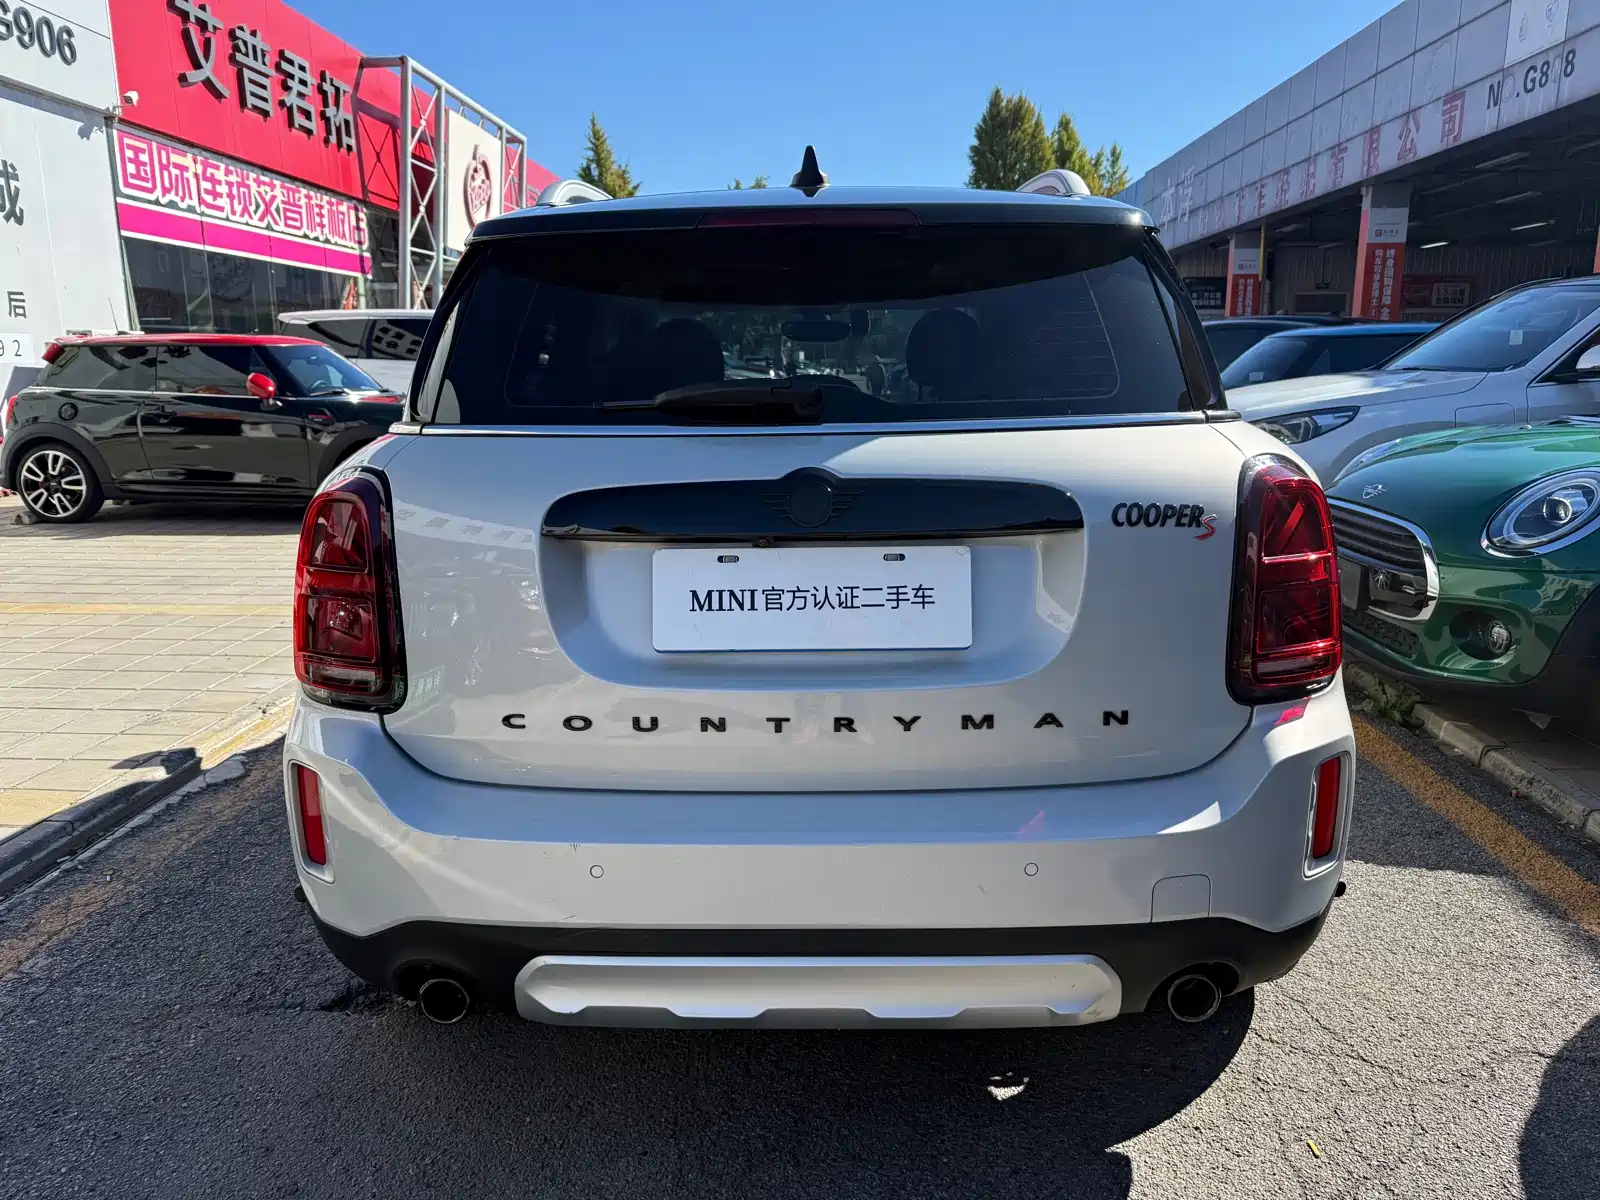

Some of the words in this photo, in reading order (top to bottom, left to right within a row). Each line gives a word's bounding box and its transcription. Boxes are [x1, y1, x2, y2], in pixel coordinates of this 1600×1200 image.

[167, 0, 356, 156] 艾普君拓
[120, 135, 368, 246] 国际连锁艾普样板店
[1111, 502, 1205, 528] COOPER
[501, 709, 1130, 733] COUNTRYMAN
